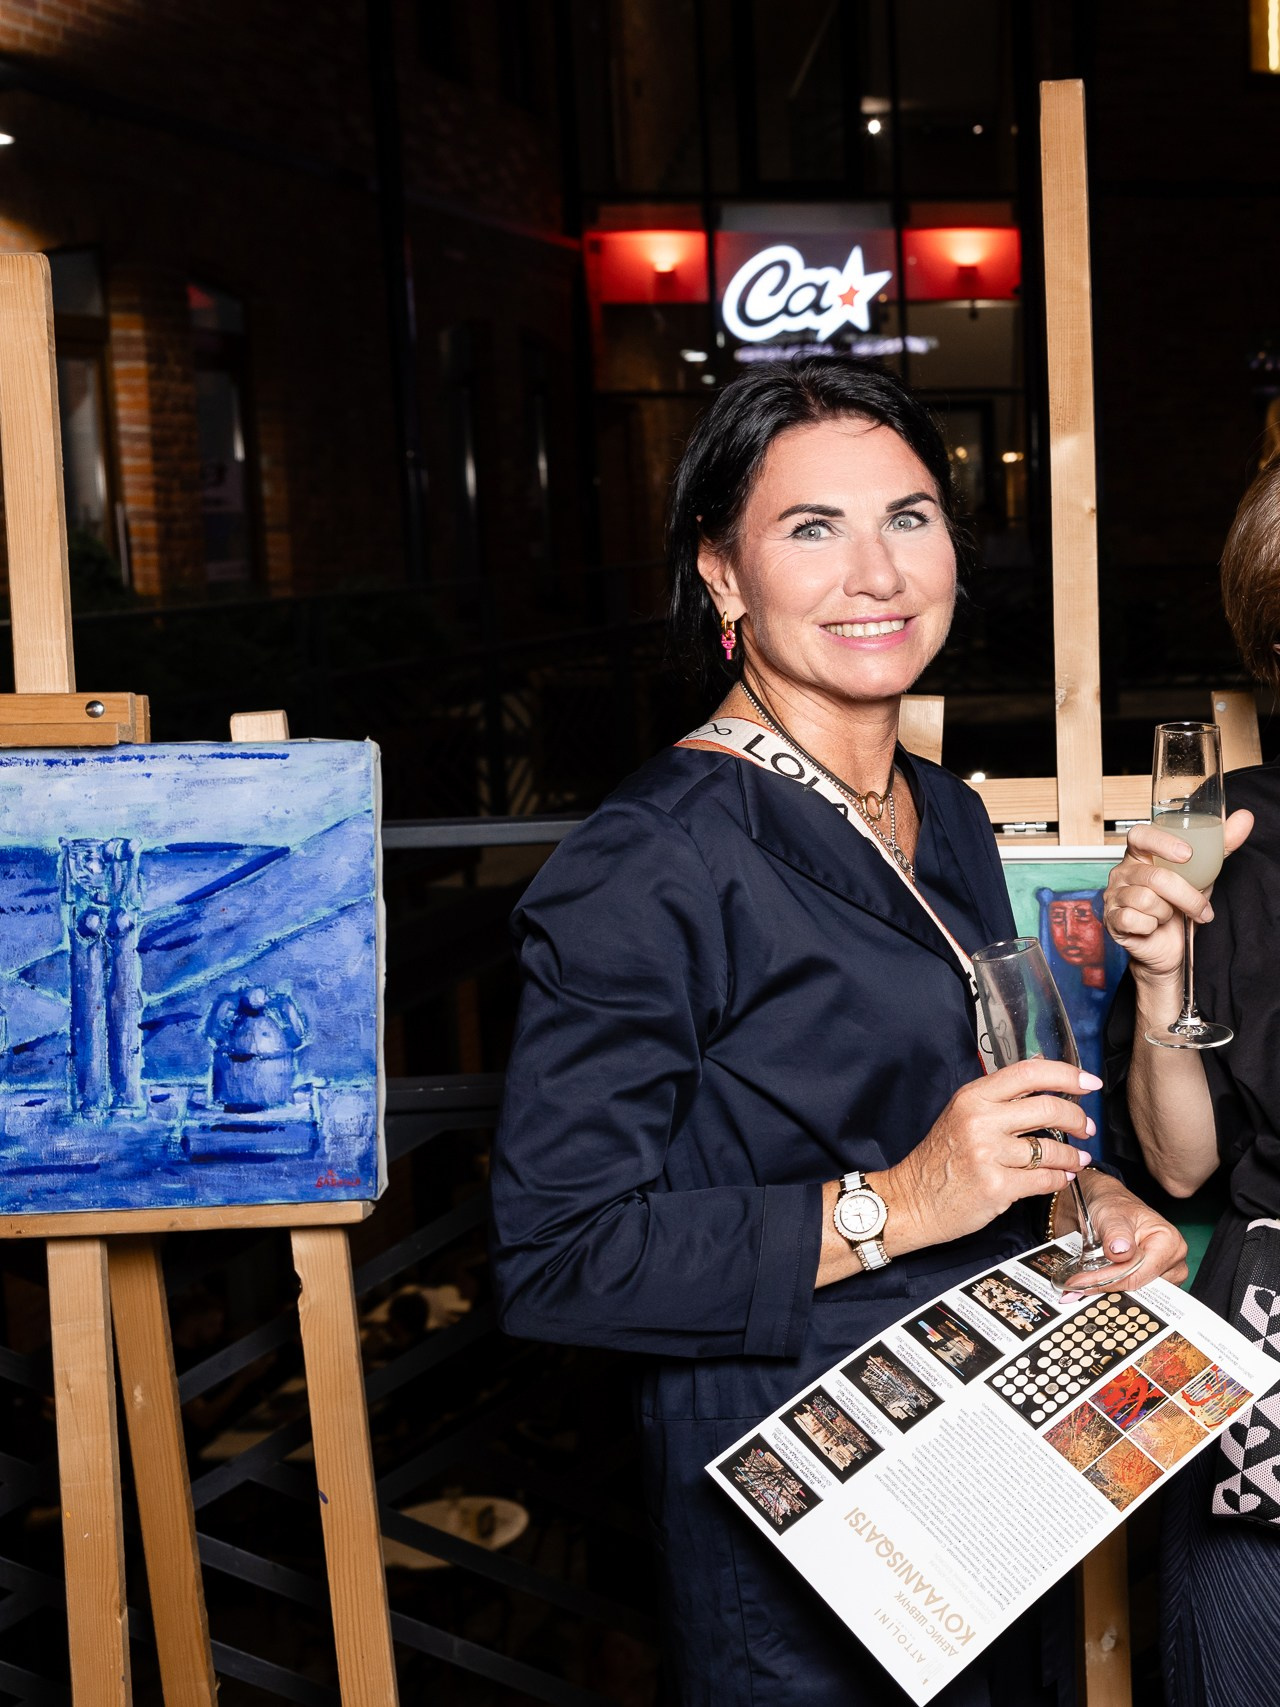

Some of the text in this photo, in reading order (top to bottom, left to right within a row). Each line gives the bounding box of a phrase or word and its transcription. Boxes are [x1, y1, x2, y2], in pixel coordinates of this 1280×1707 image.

[842, 1504, 977, 1646] KOYAANISQATSI
[893, 1589, 928, 1626] ШЕВЧУК
[872, 1607, 926, 1664] ATTOLINI
[925, 1623, 958, 1659] ДЕНИС
